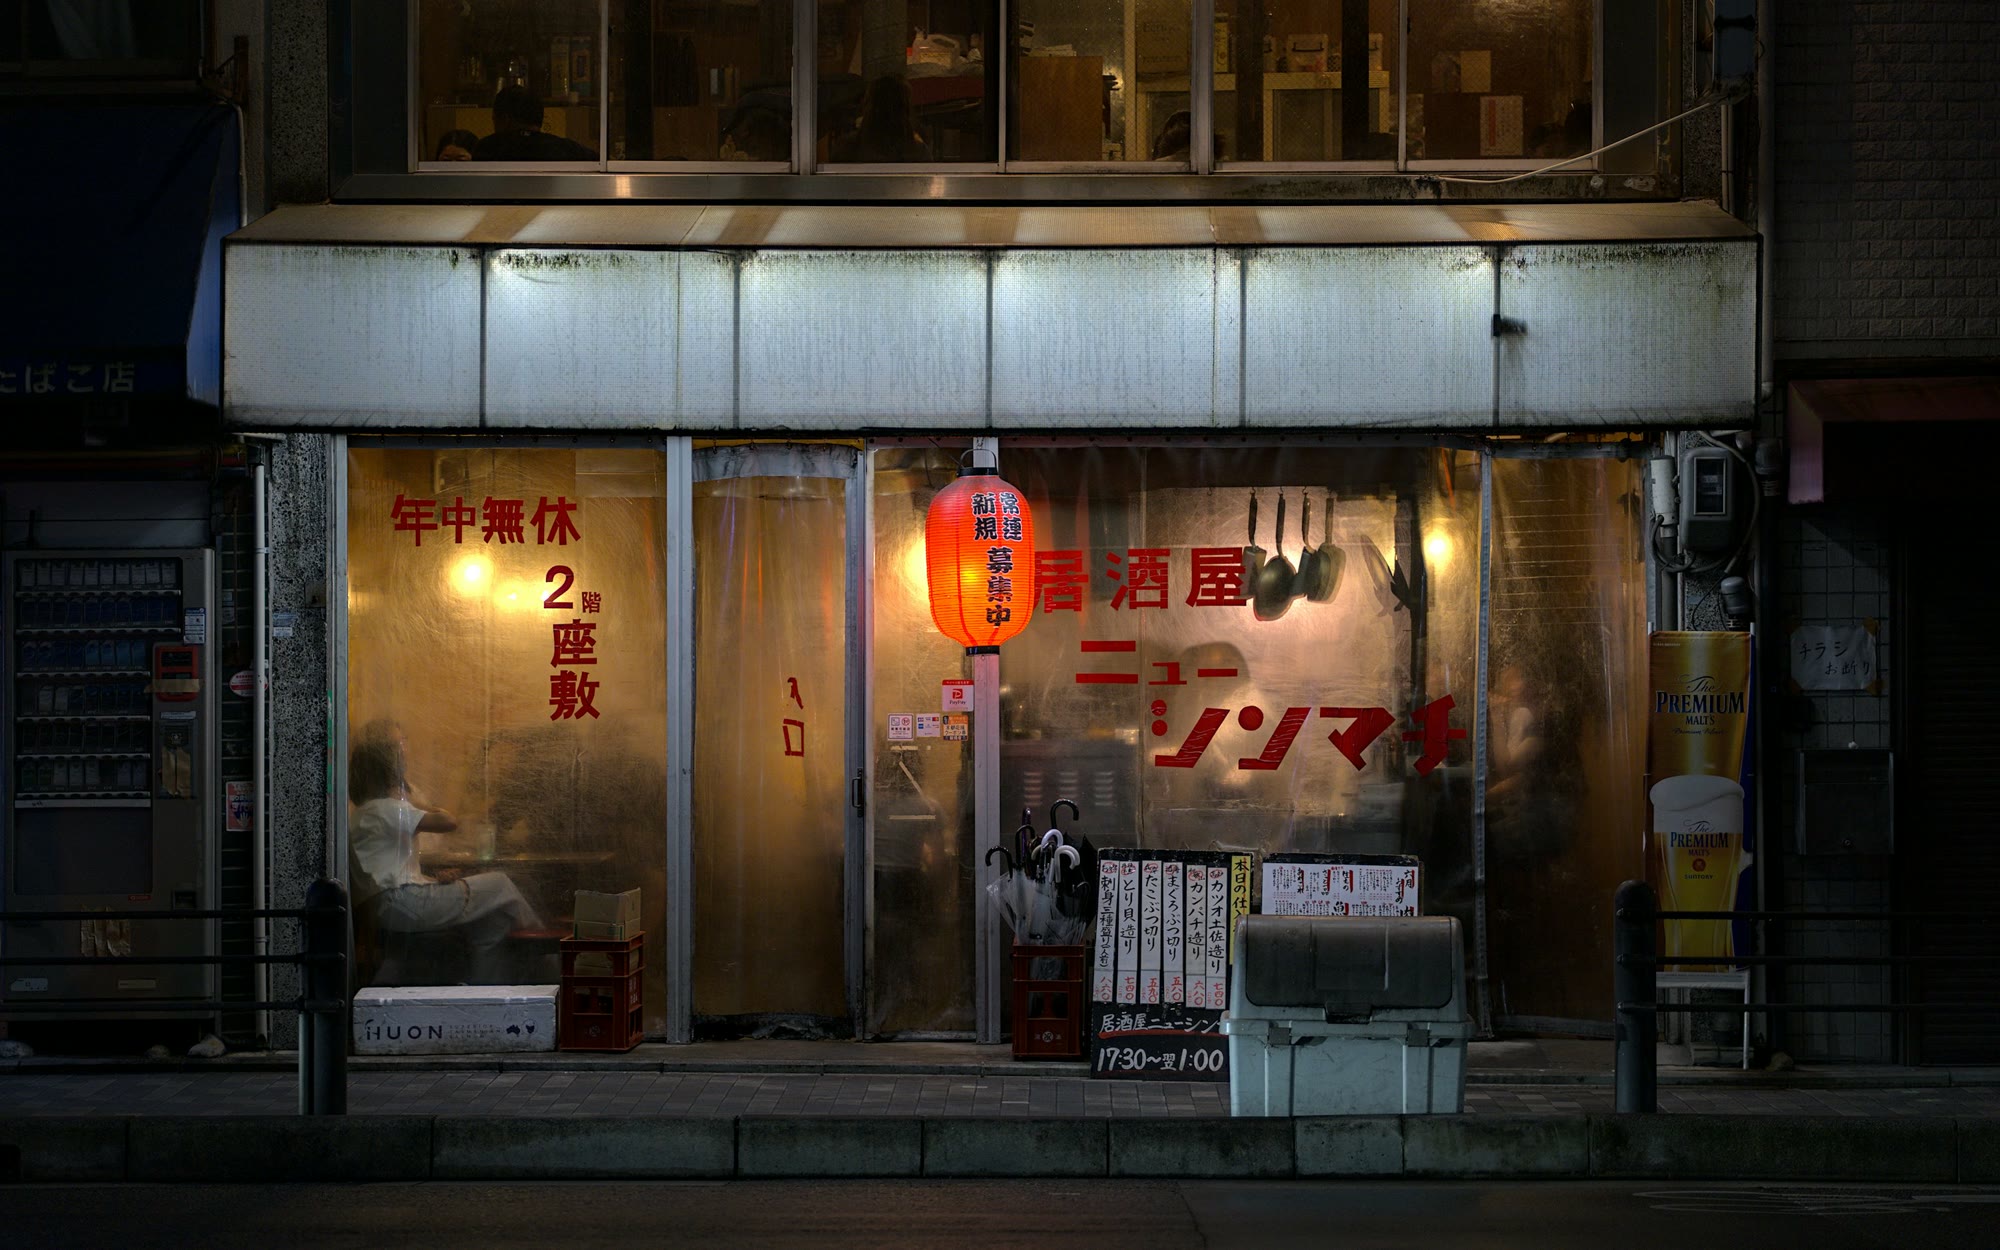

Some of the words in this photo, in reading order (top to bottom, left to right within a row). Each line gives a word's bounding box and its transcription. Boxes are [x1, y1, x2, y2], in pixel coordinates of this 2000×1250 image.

[390, 494, 581, 547] 年中無休
[971, 493, 998, 541] 新規
[1000, 492, 1022, 541] 常連
[985, 547, 1013, 628] 募集中
[1034, 547, 1247, 613] 居酒屋
[1075, 640, 1239, 686] ニュー
[1800, 641, 1848, 660] チラシ
[1825, 660, 1869, 675] お断り
[1656, 691, 1745, 713] PREMIUM
[1682, 675, 1718, 693] The
[1150, 694, 1467, 777] シンマチ
[1686, 715, 1715, 725] MALT'S
[1670, 832, 1729, 848] PREMIUM
[1684, 820, 1714, 833] The
[1232, 859, 1249, 932] 本日の仕入
[1404, 869, 1414, 889] 六月
[1120, 879, 1137, 955] とり貝造り
[1143, 874, 1160, 951] たこぶつ切り
[1166, 875, 1182, 961] まぐろぶつ切り
[1188, 882, 1204, 960] カンパチ造り
[1208, 880, 1225, 974] カツオ土佐造り
[365, 1019, 442, 1040] HUON
[1100, 1012, 1221, 1034] 居酒屋ニューシン
